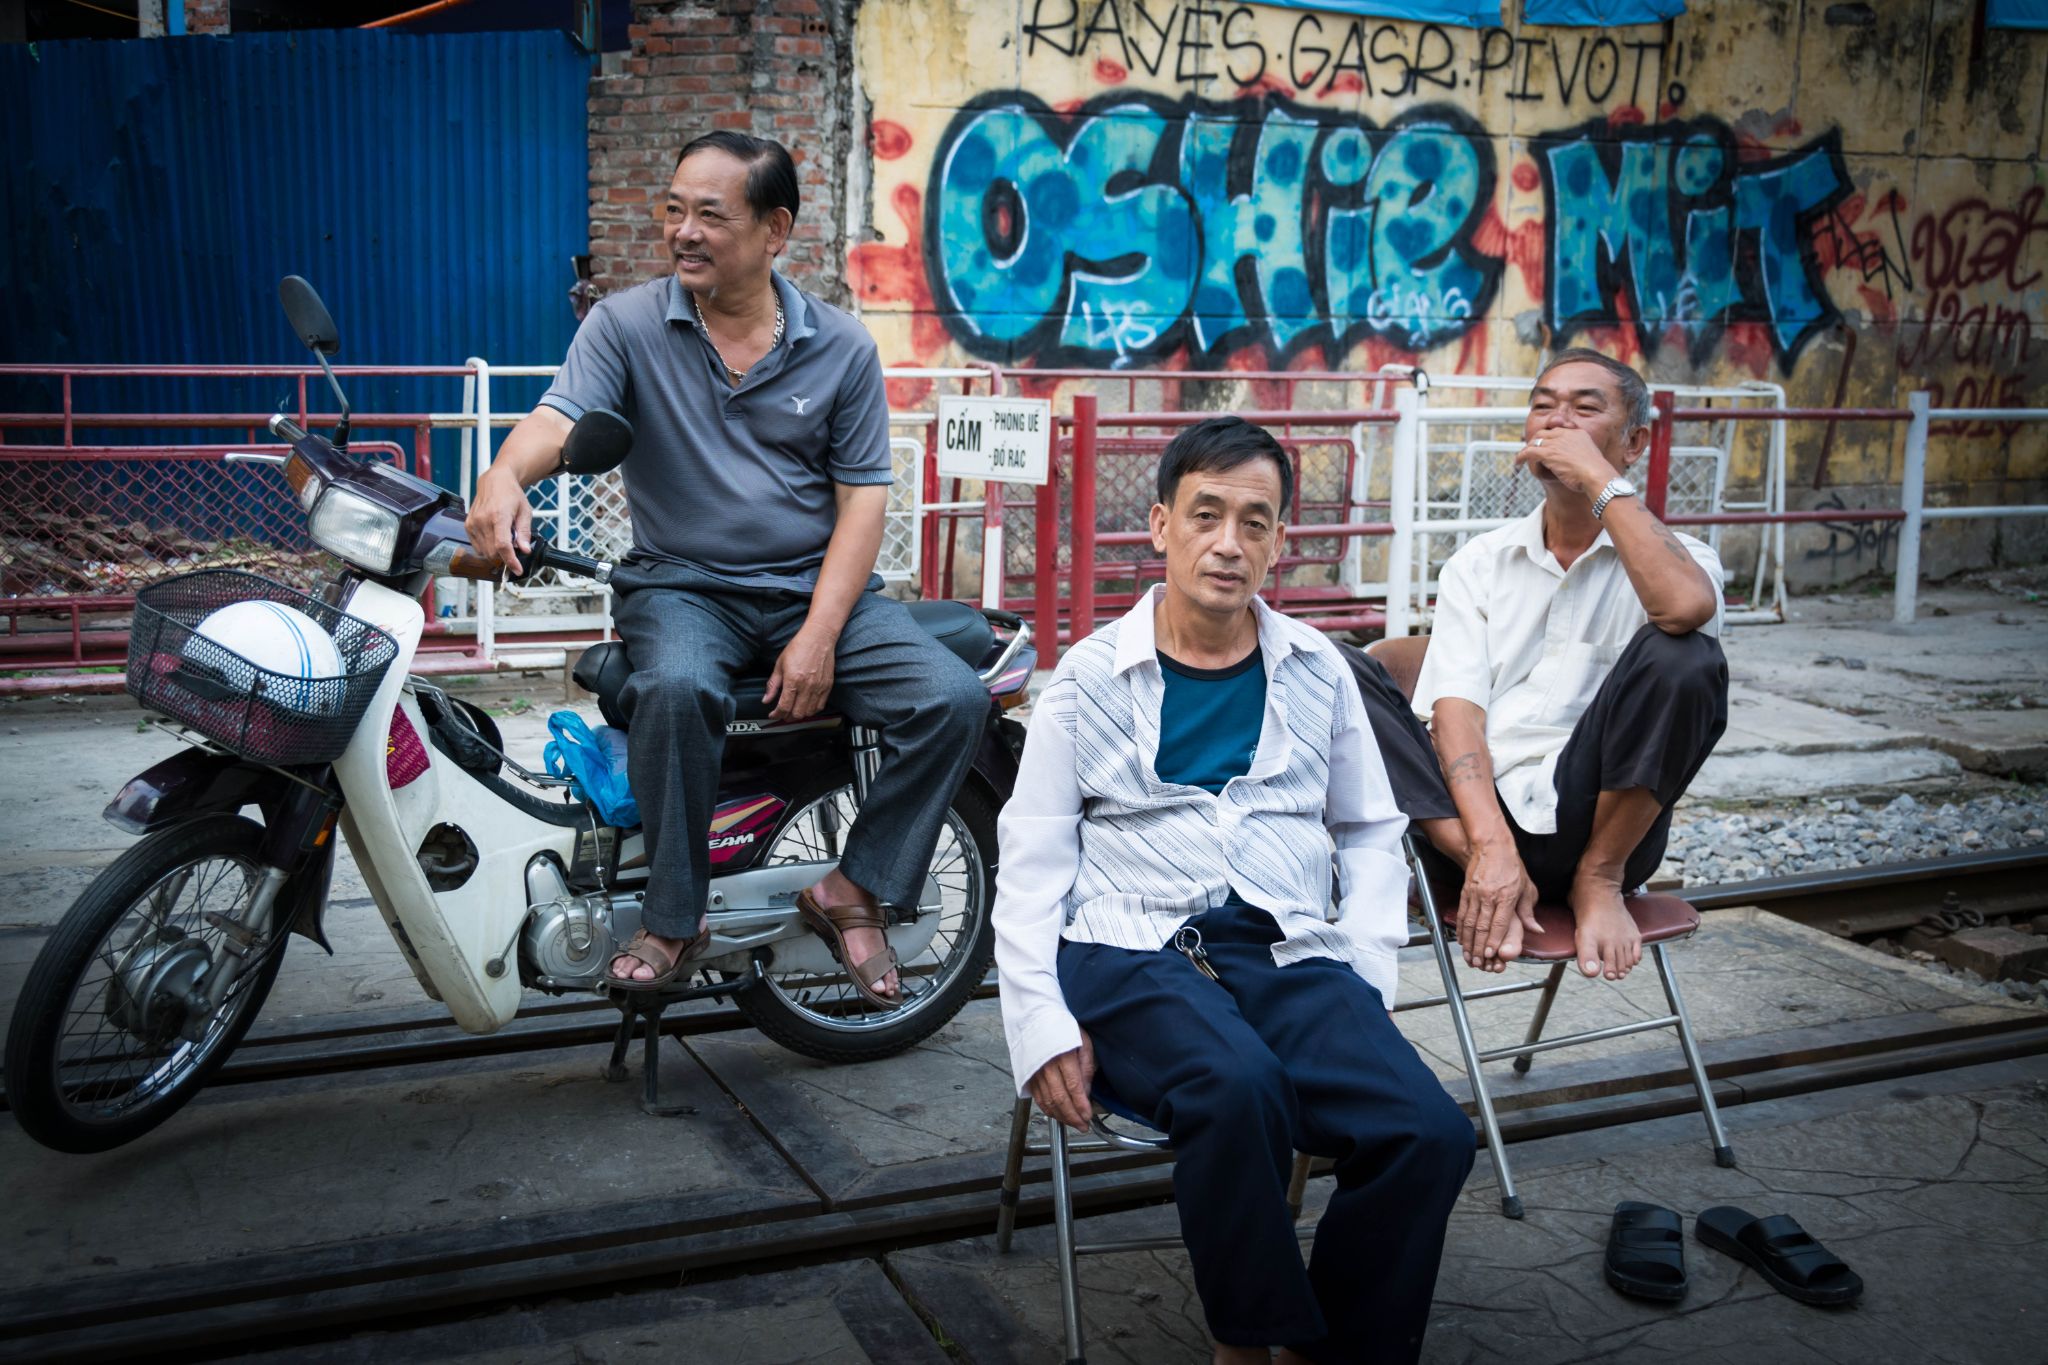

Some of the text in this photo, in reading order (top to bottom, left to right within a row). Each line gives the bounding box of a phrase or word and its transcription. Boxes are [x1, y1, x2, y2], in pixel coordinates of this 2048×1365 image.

[946, 408, 982, 452] CẤM
[726, 722, 762, 732] NDA
[708, 833, 755, 850] EAM
